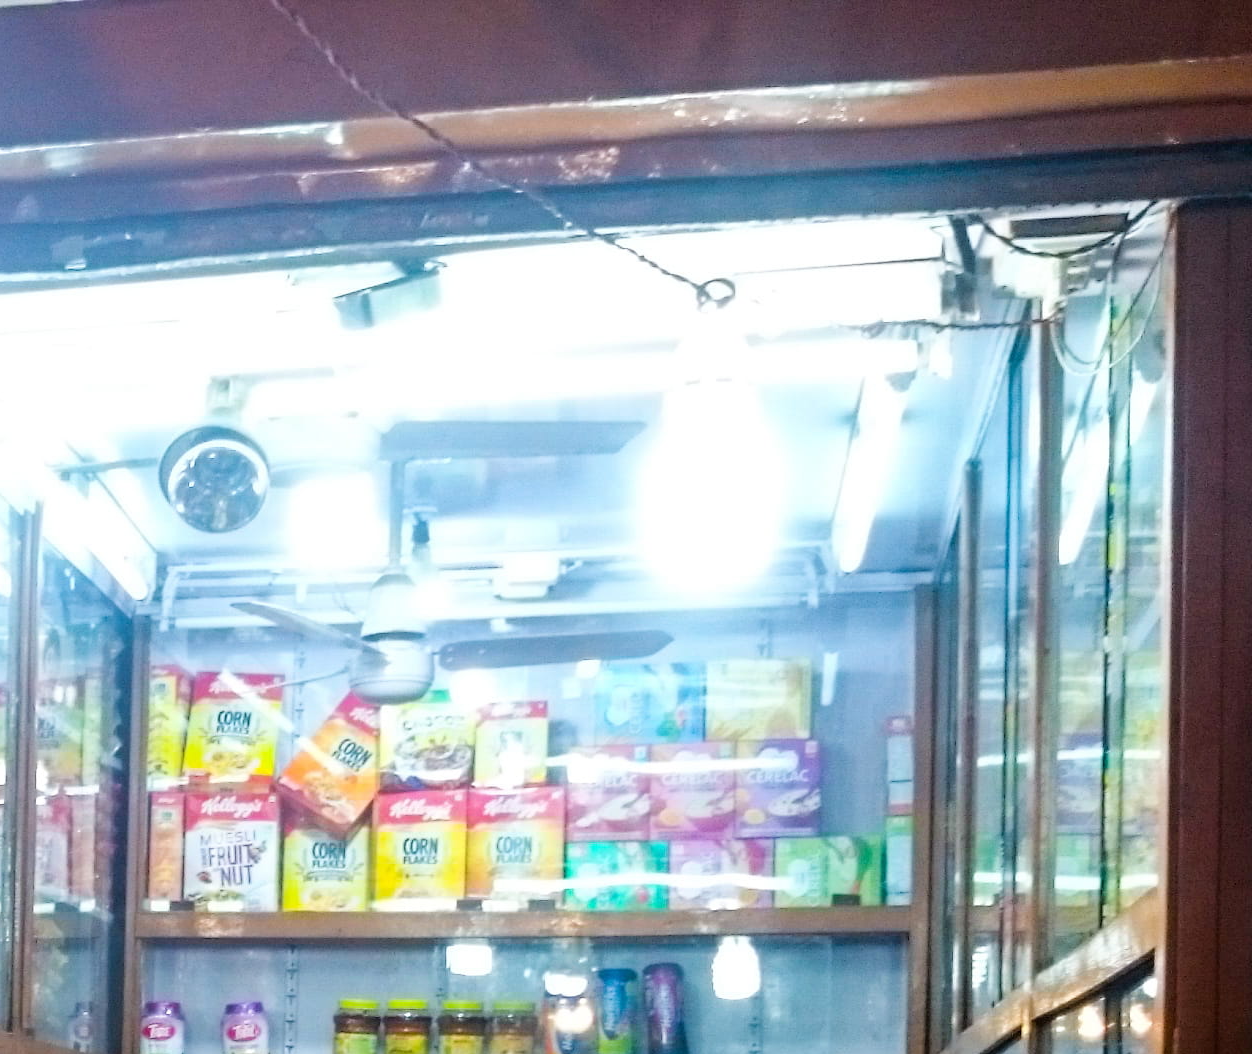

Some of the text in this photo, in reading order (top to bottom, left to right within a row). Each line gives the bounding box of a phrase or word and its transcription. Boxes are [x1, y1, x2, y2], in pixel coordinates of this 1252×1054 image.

[216, 710, 252, 726] CORN
[338, 738, 373, 767] CORN
[200, 796, 263, 819] Kellogg's
[200, 831, 257, 847] MUESLI
[403, 838, 439, 855] CORN
[496, 836, 532, 854] CORN
[209, 844, 253, 867] FRUIT
[312, 840, 347, 859] CORN
[312, 860, 346, 869] FLAKES
[403, 856, 438, 865] FLAKES
[496, 855, 532, 864] FLAKES
[220, 865, 254, 887] NUT
